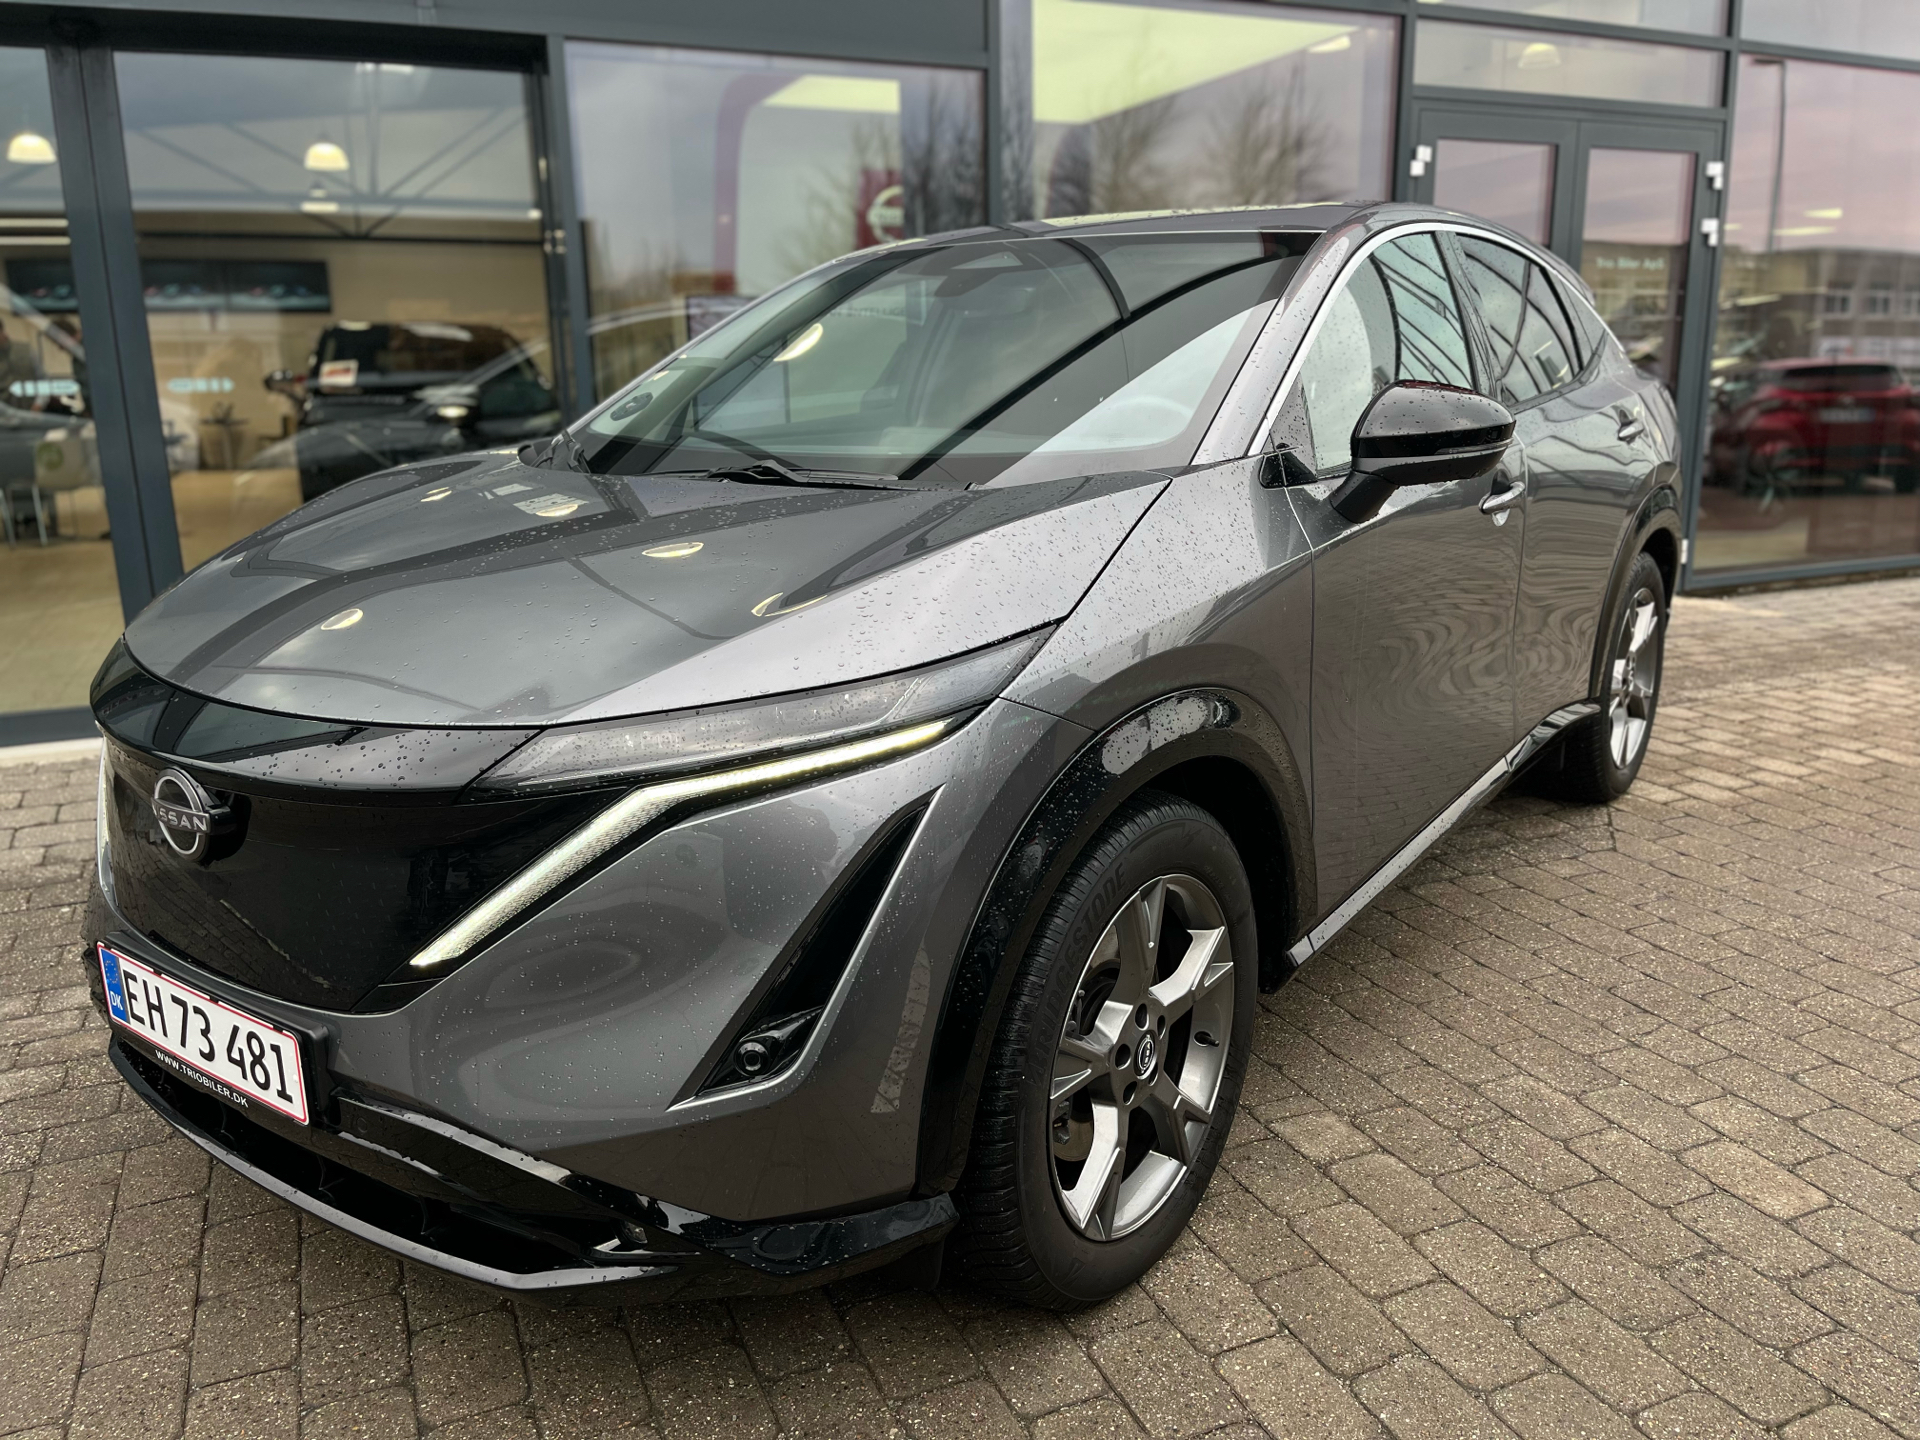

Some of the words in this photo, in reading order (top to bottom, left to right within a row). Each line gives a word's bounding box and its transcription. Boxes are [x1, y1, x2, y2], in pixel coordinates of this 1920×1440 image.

[109, 989, 124, 1011] DK
[1024, 862, 1126, 1086] BRIDGESTONE
[121, 969, 168, 1038] EH
[170, 993, 216, 1063] 73
[226, 1023, 294, 1105] 481
[155, 1050, 249, 1108] WWW.TRIOBILER.DK
